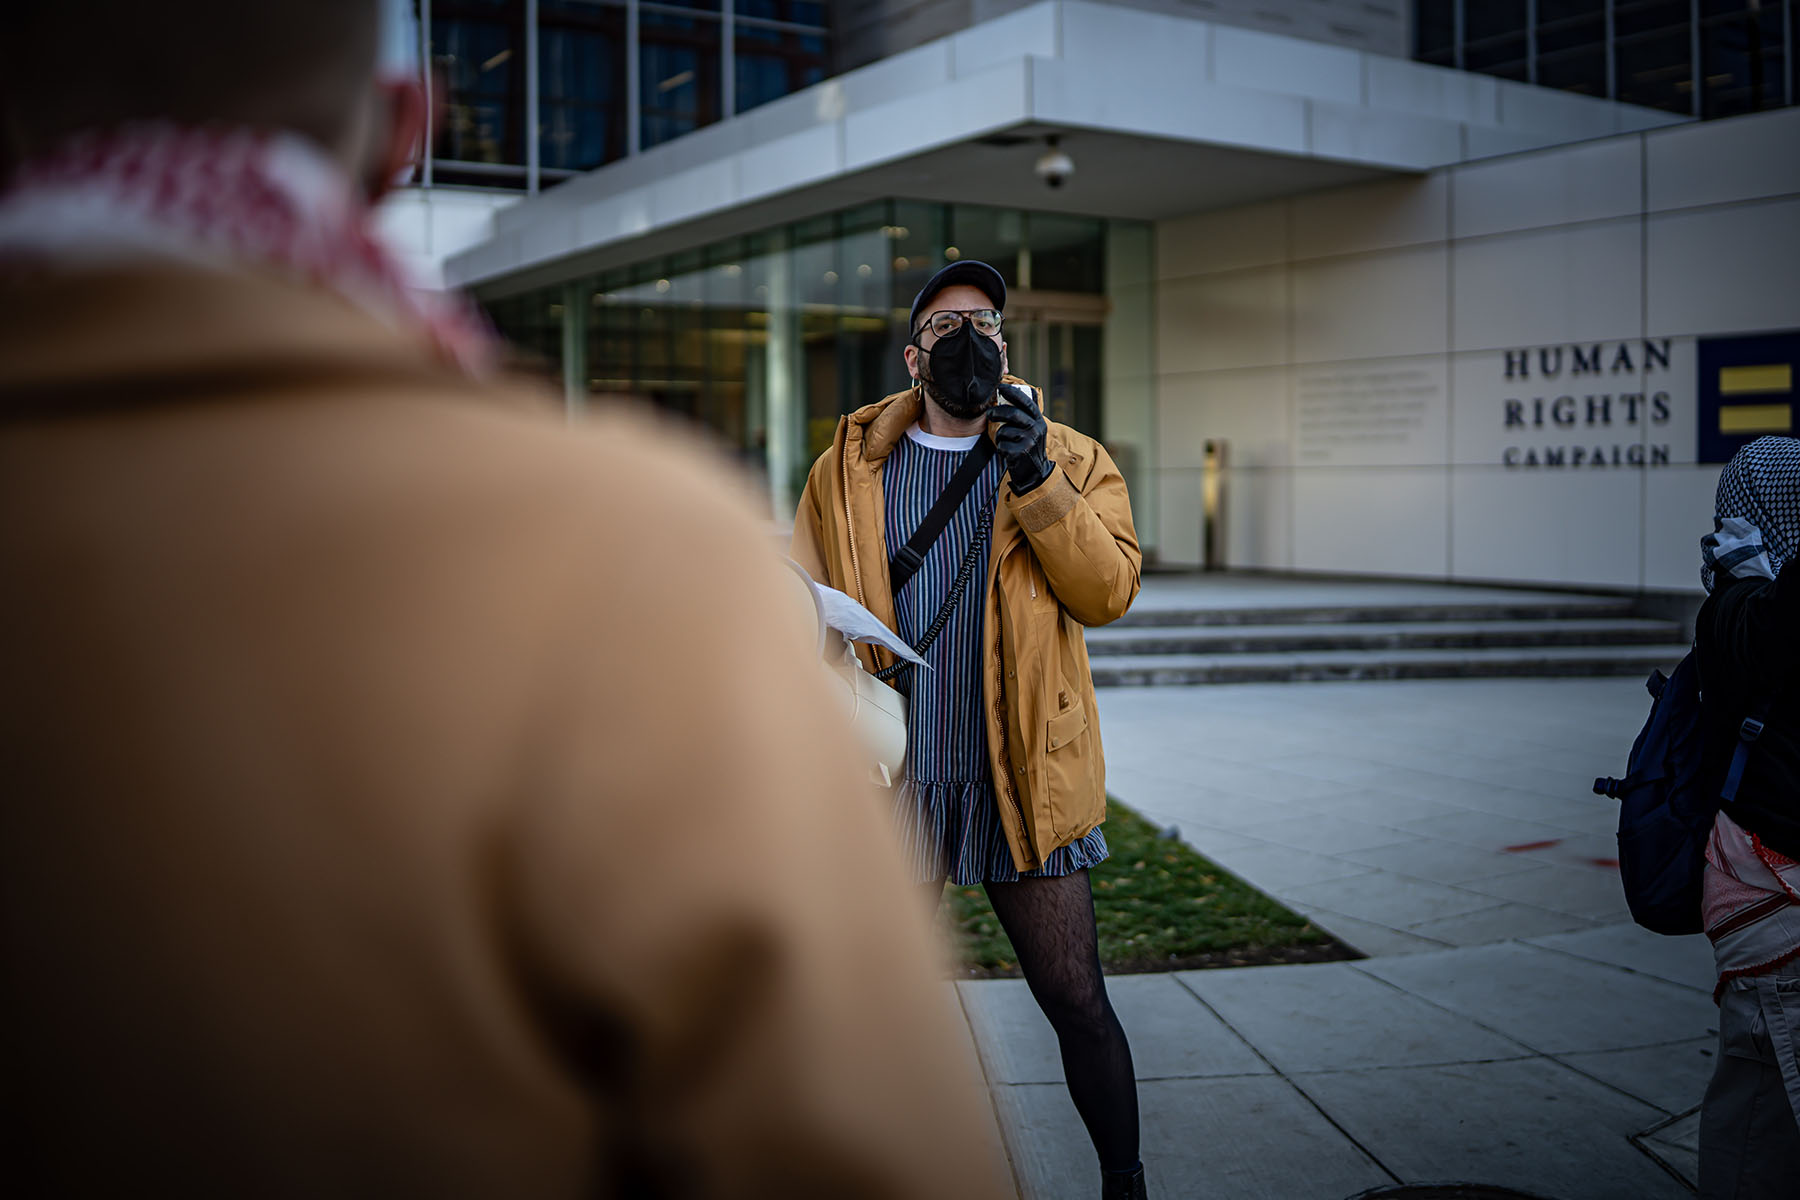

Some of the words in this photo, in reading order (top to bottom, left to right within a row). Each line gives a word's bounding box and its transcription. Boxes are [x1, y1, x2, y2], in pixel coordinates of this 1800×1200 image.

[1504, 338, 1671, 380] HUMAN
[1504, 392, 1671, 429] RIGHTS
[1503, 443, 1670, 469] CAMPAIGN
